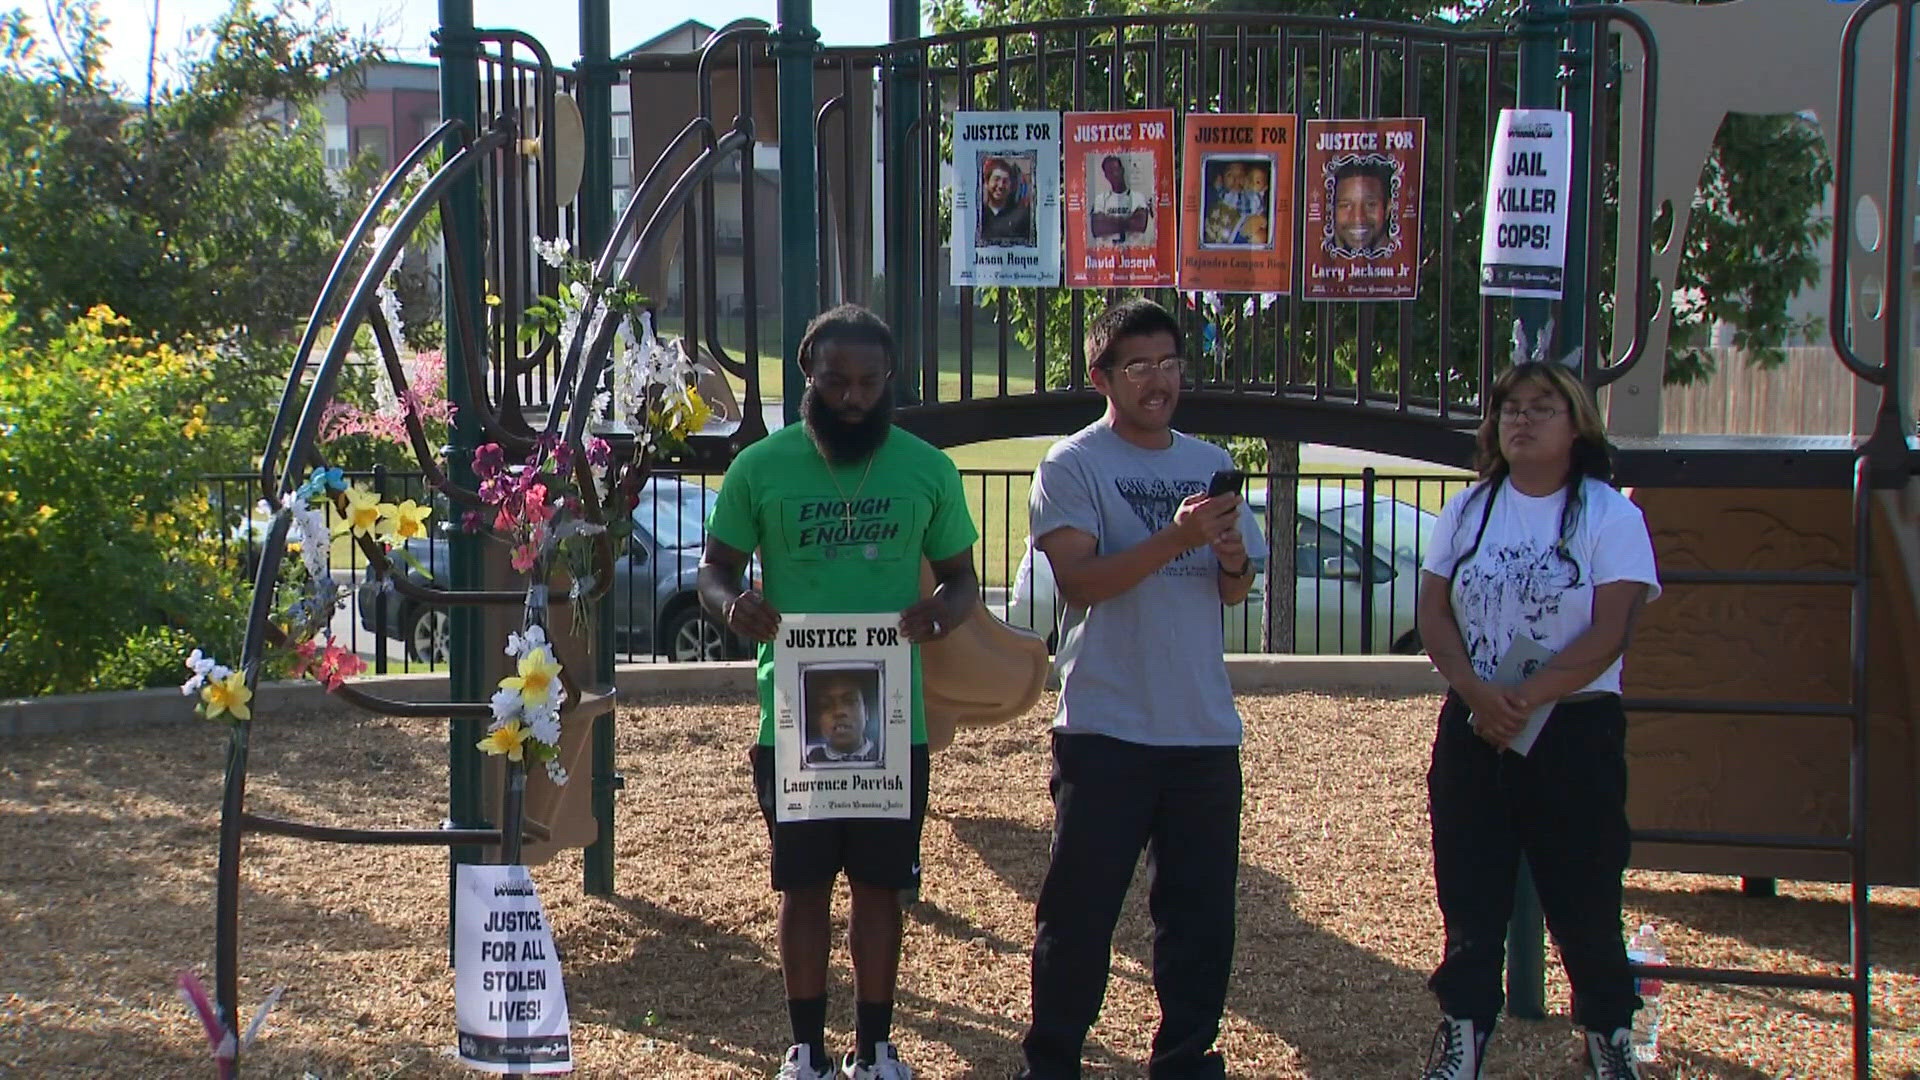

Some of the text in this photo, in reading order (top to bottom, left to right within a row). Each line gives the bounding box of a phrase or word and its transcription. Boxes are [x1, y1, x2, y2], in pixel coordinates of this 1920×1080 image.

[963, 123, 1050, 141] JUSTICE FOR
[1074, 123, 1165, 142] JUSTICE FOR
[1195, 127, 1287, 144] JUSTICE FOR
[1316, 132, 1414, 150] JUSTICE FOR
[1507, 152, 1547, 177] JAIL
[1497, 188, 1555, 214] KILLER
[1498, 223, 1550, 250] COPS!
[973, 252, 1003, 265] Jason
[1085, 254, 1156, 272] David Joseph
[1312, 263, 1410, 282] Larry Jackson Jr
[798, 497, 891, 522] ENOUGH
[799, 523, 899, 548] ENOUGH
[786, 627, 898, 648] JUSTICE FOR
[784, 774, 903, 793] Lawrence Parrish
[484, 911, 542, 932] JUSTICE
[482, 940, 546, 962] FOR ALL
[483, 969, 546, 992] STOLEN
[489, 1000, 541, 1022] LIVES!
